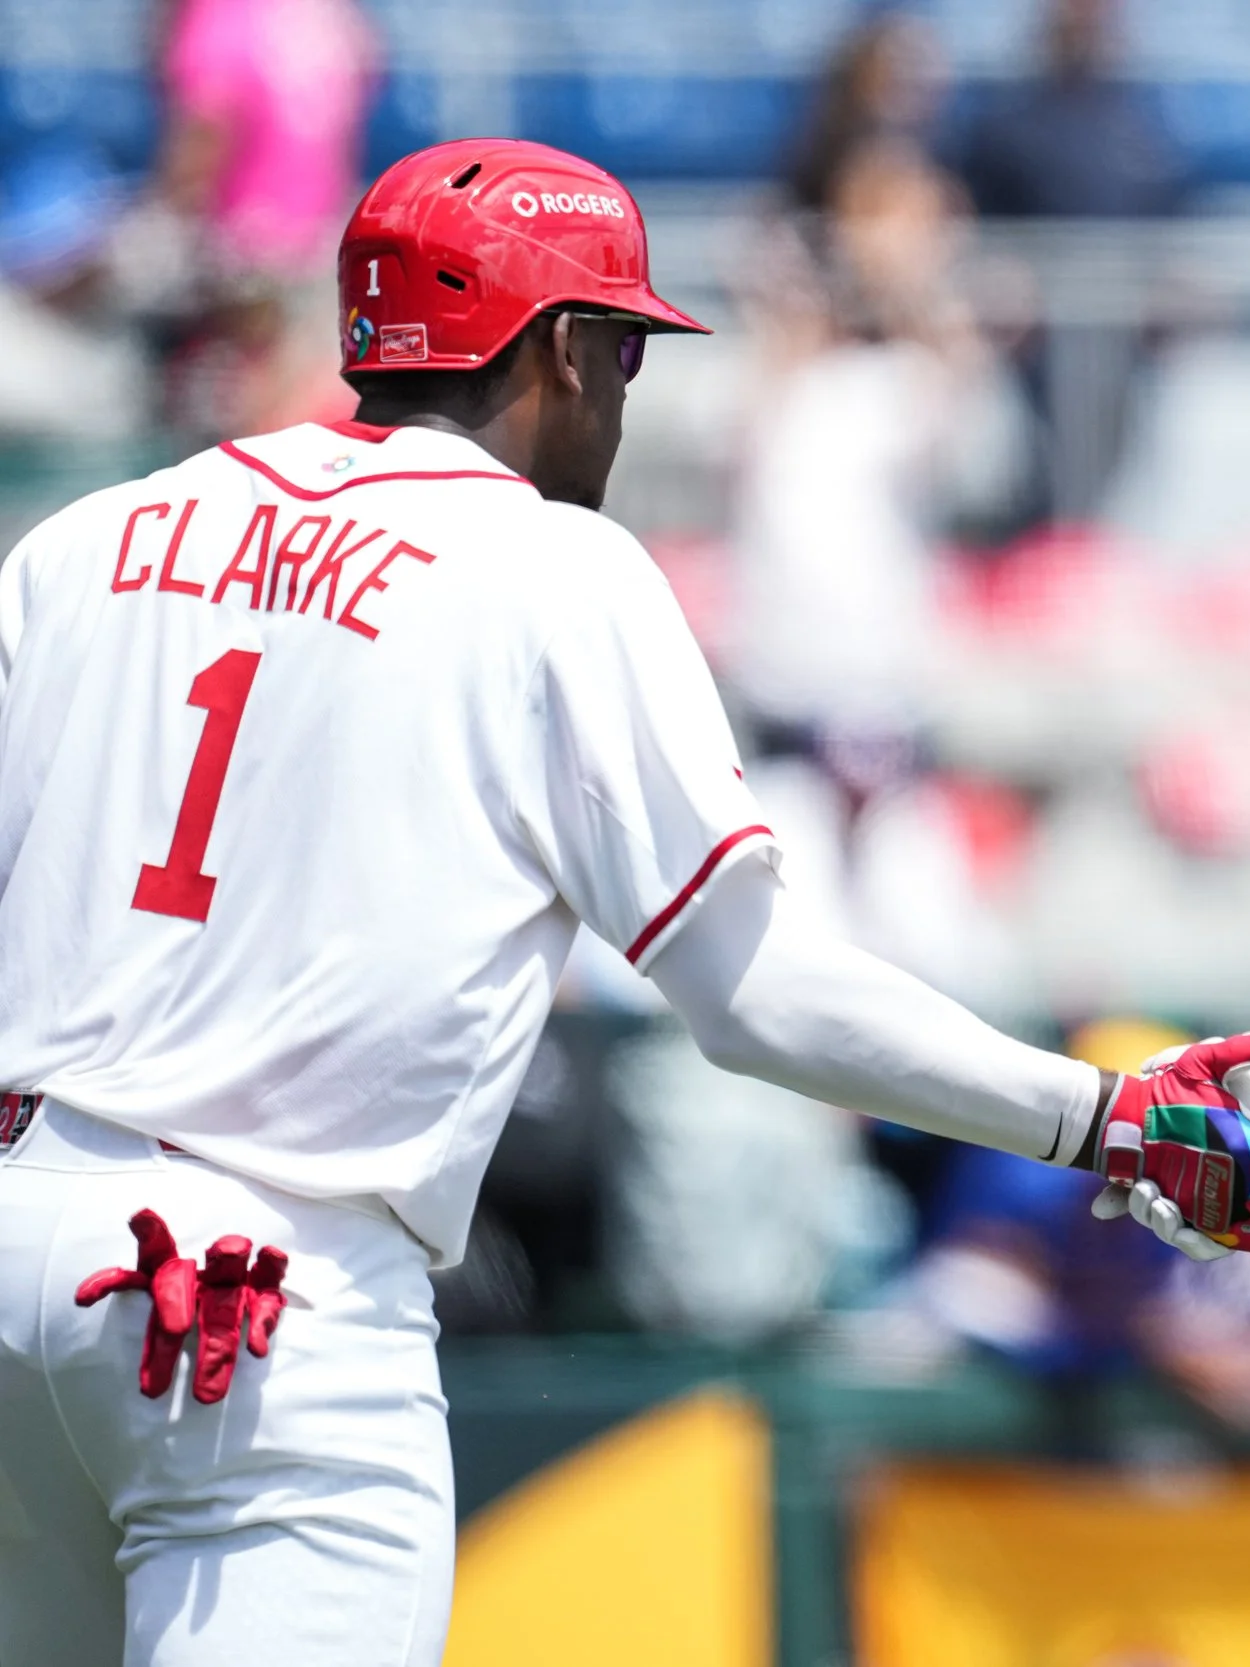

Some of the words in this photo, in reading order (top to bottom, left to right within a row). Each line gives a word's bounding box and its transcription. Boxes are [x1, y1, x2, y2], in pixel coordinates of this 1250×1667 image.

[542, 192, 625, 219] ROGERS
[366, 259, 381, 297] 1
[111, 498, 438, 642] CLARKE
[130, 648, 263, 923] 1
[1202, 1157, 1228, 1230] Franklin
